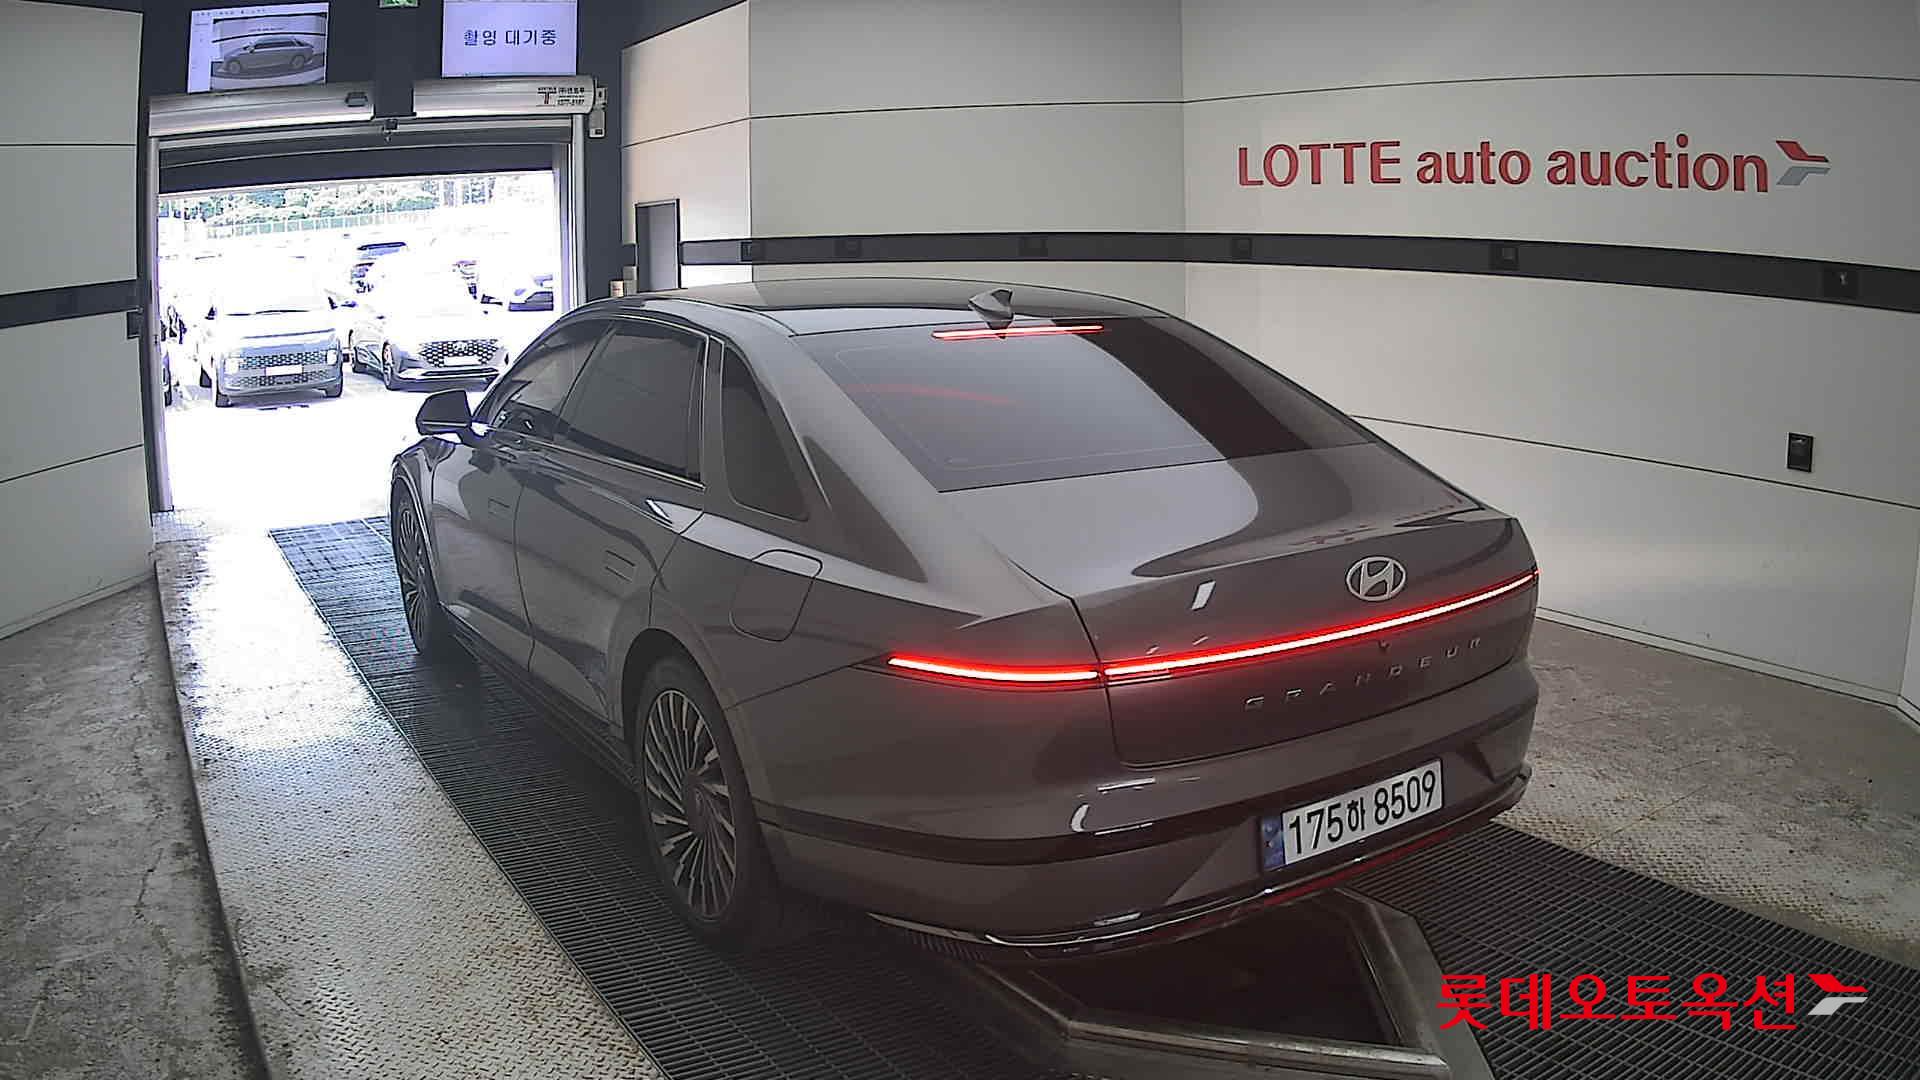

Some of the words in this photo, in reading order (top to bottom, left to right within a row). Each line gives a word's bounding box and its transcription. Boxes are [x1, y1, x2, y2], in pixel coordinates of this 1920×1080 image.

[505, 29, 558, 46] 대기중
[1238, 141, 1402, 188] LOTTE
[1416, 141, 1532, 186] auto
[1546, 133, 1769, 193] auction
[1288, 797, 1367, 855] 175하
[1373, 769, 1437, 826] 8509
